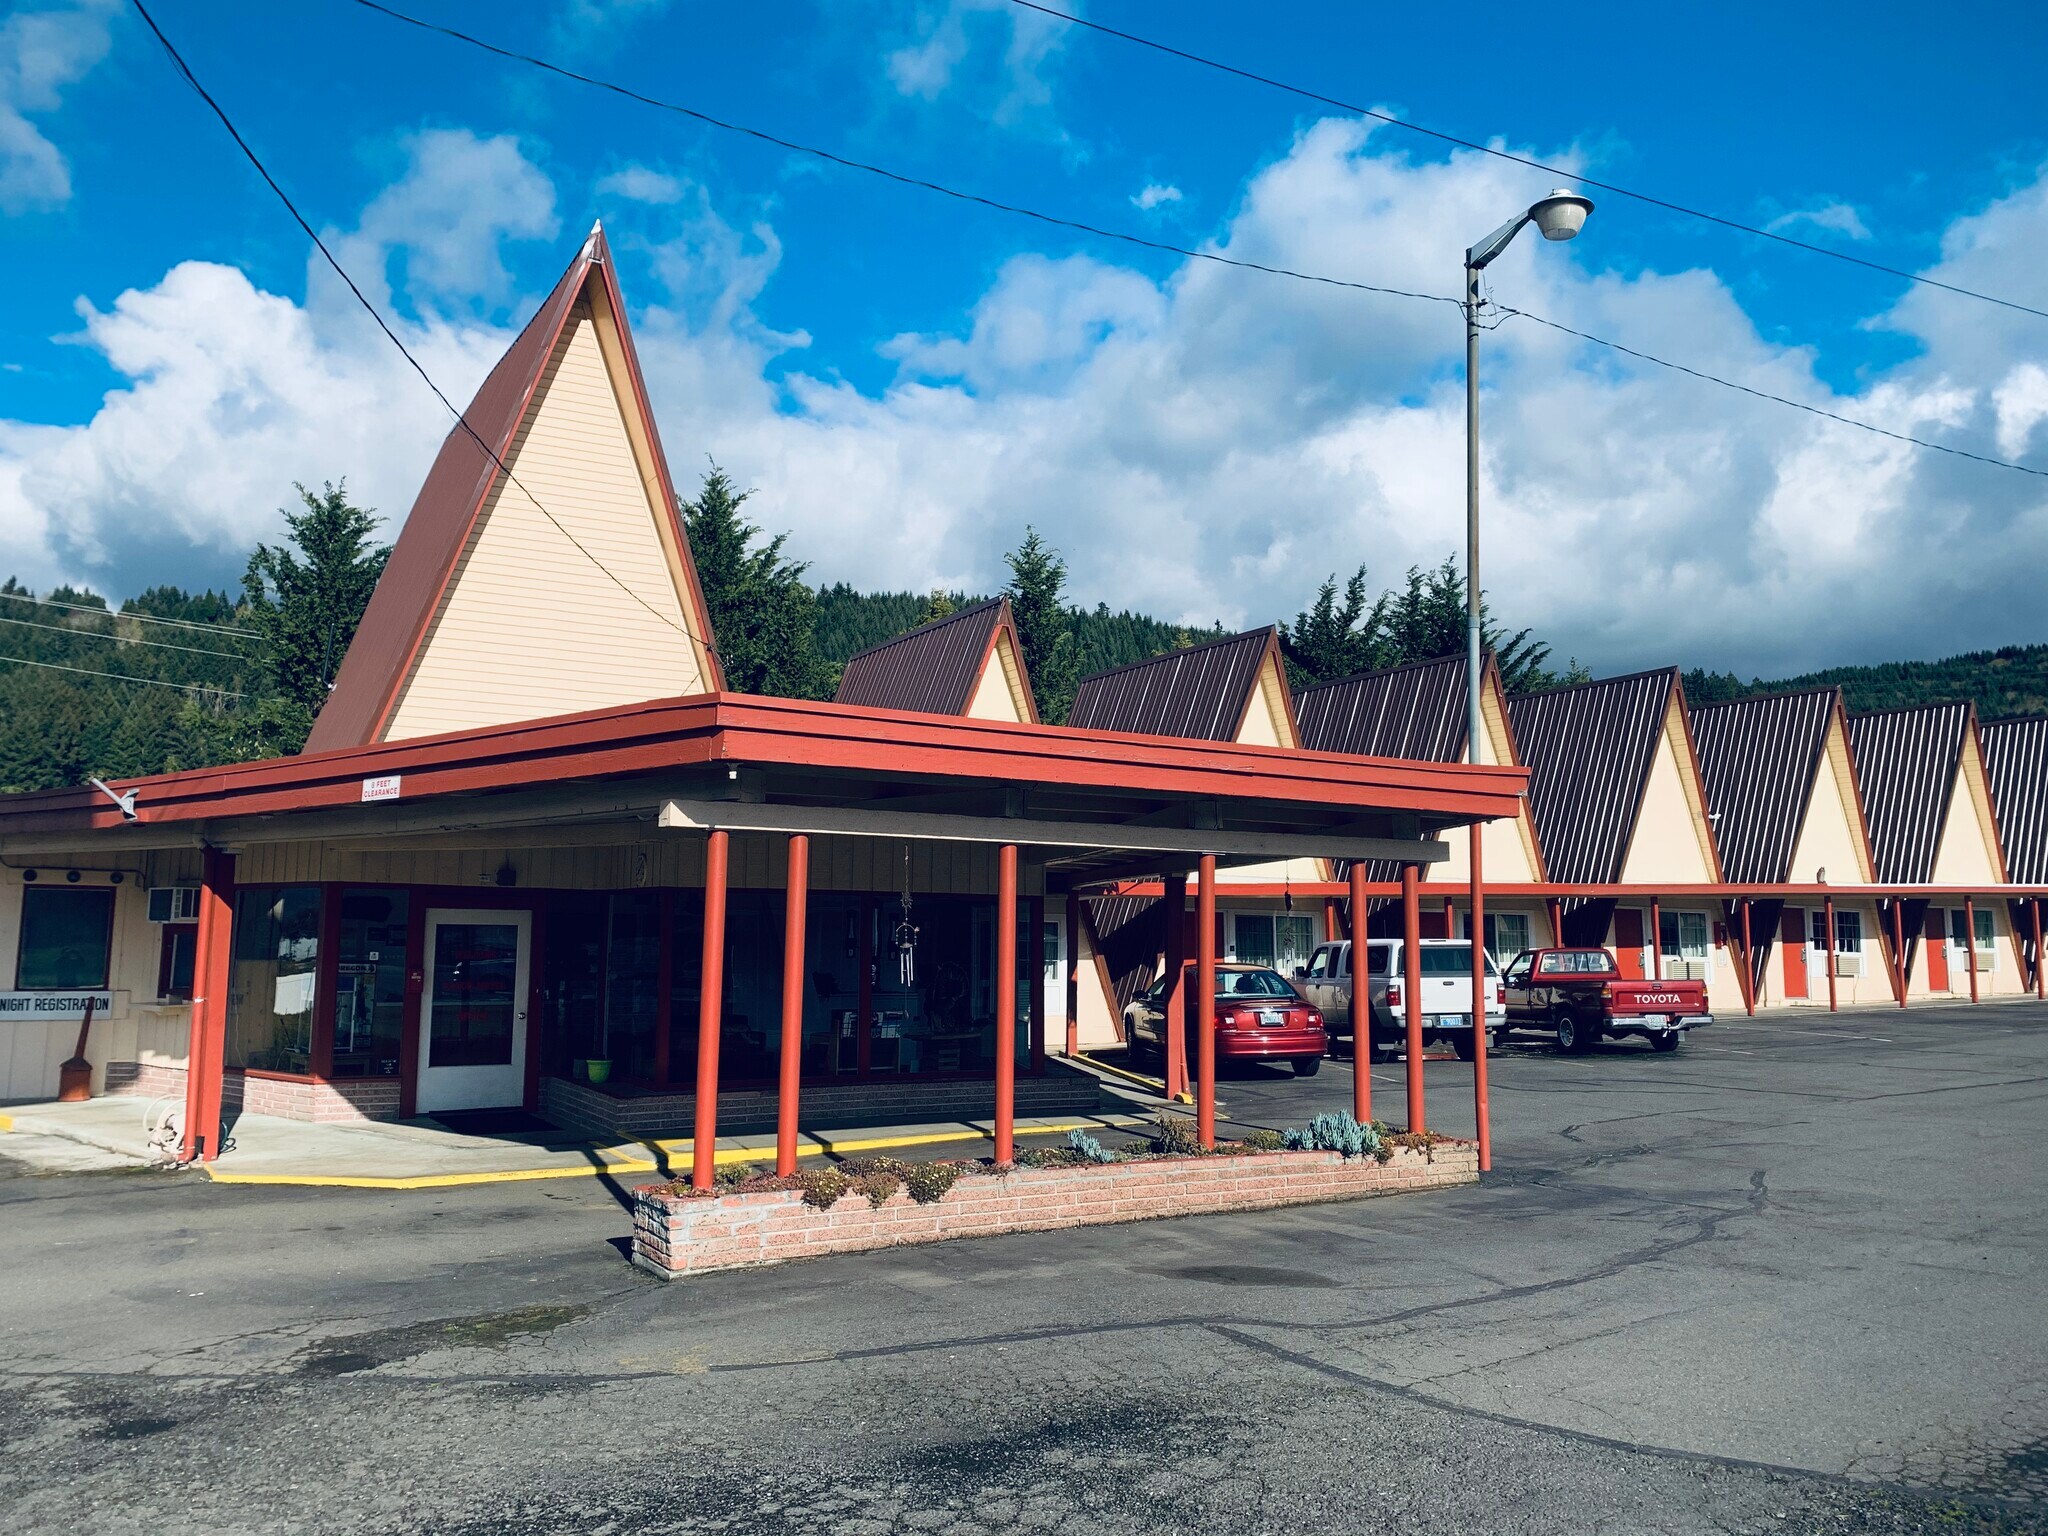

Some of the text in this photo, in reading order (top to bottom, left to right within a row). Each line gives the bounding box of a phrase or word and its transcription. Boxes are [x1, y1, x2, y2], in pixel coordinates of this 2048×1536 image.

[376, 779, 391, 788] FEET
[363, 787, 398, 798] CLEARANCE
[1634, 994, 1681, 1004] TOYOTA
[0, 998, 109, 1011] NIGHT REGISTRAON
